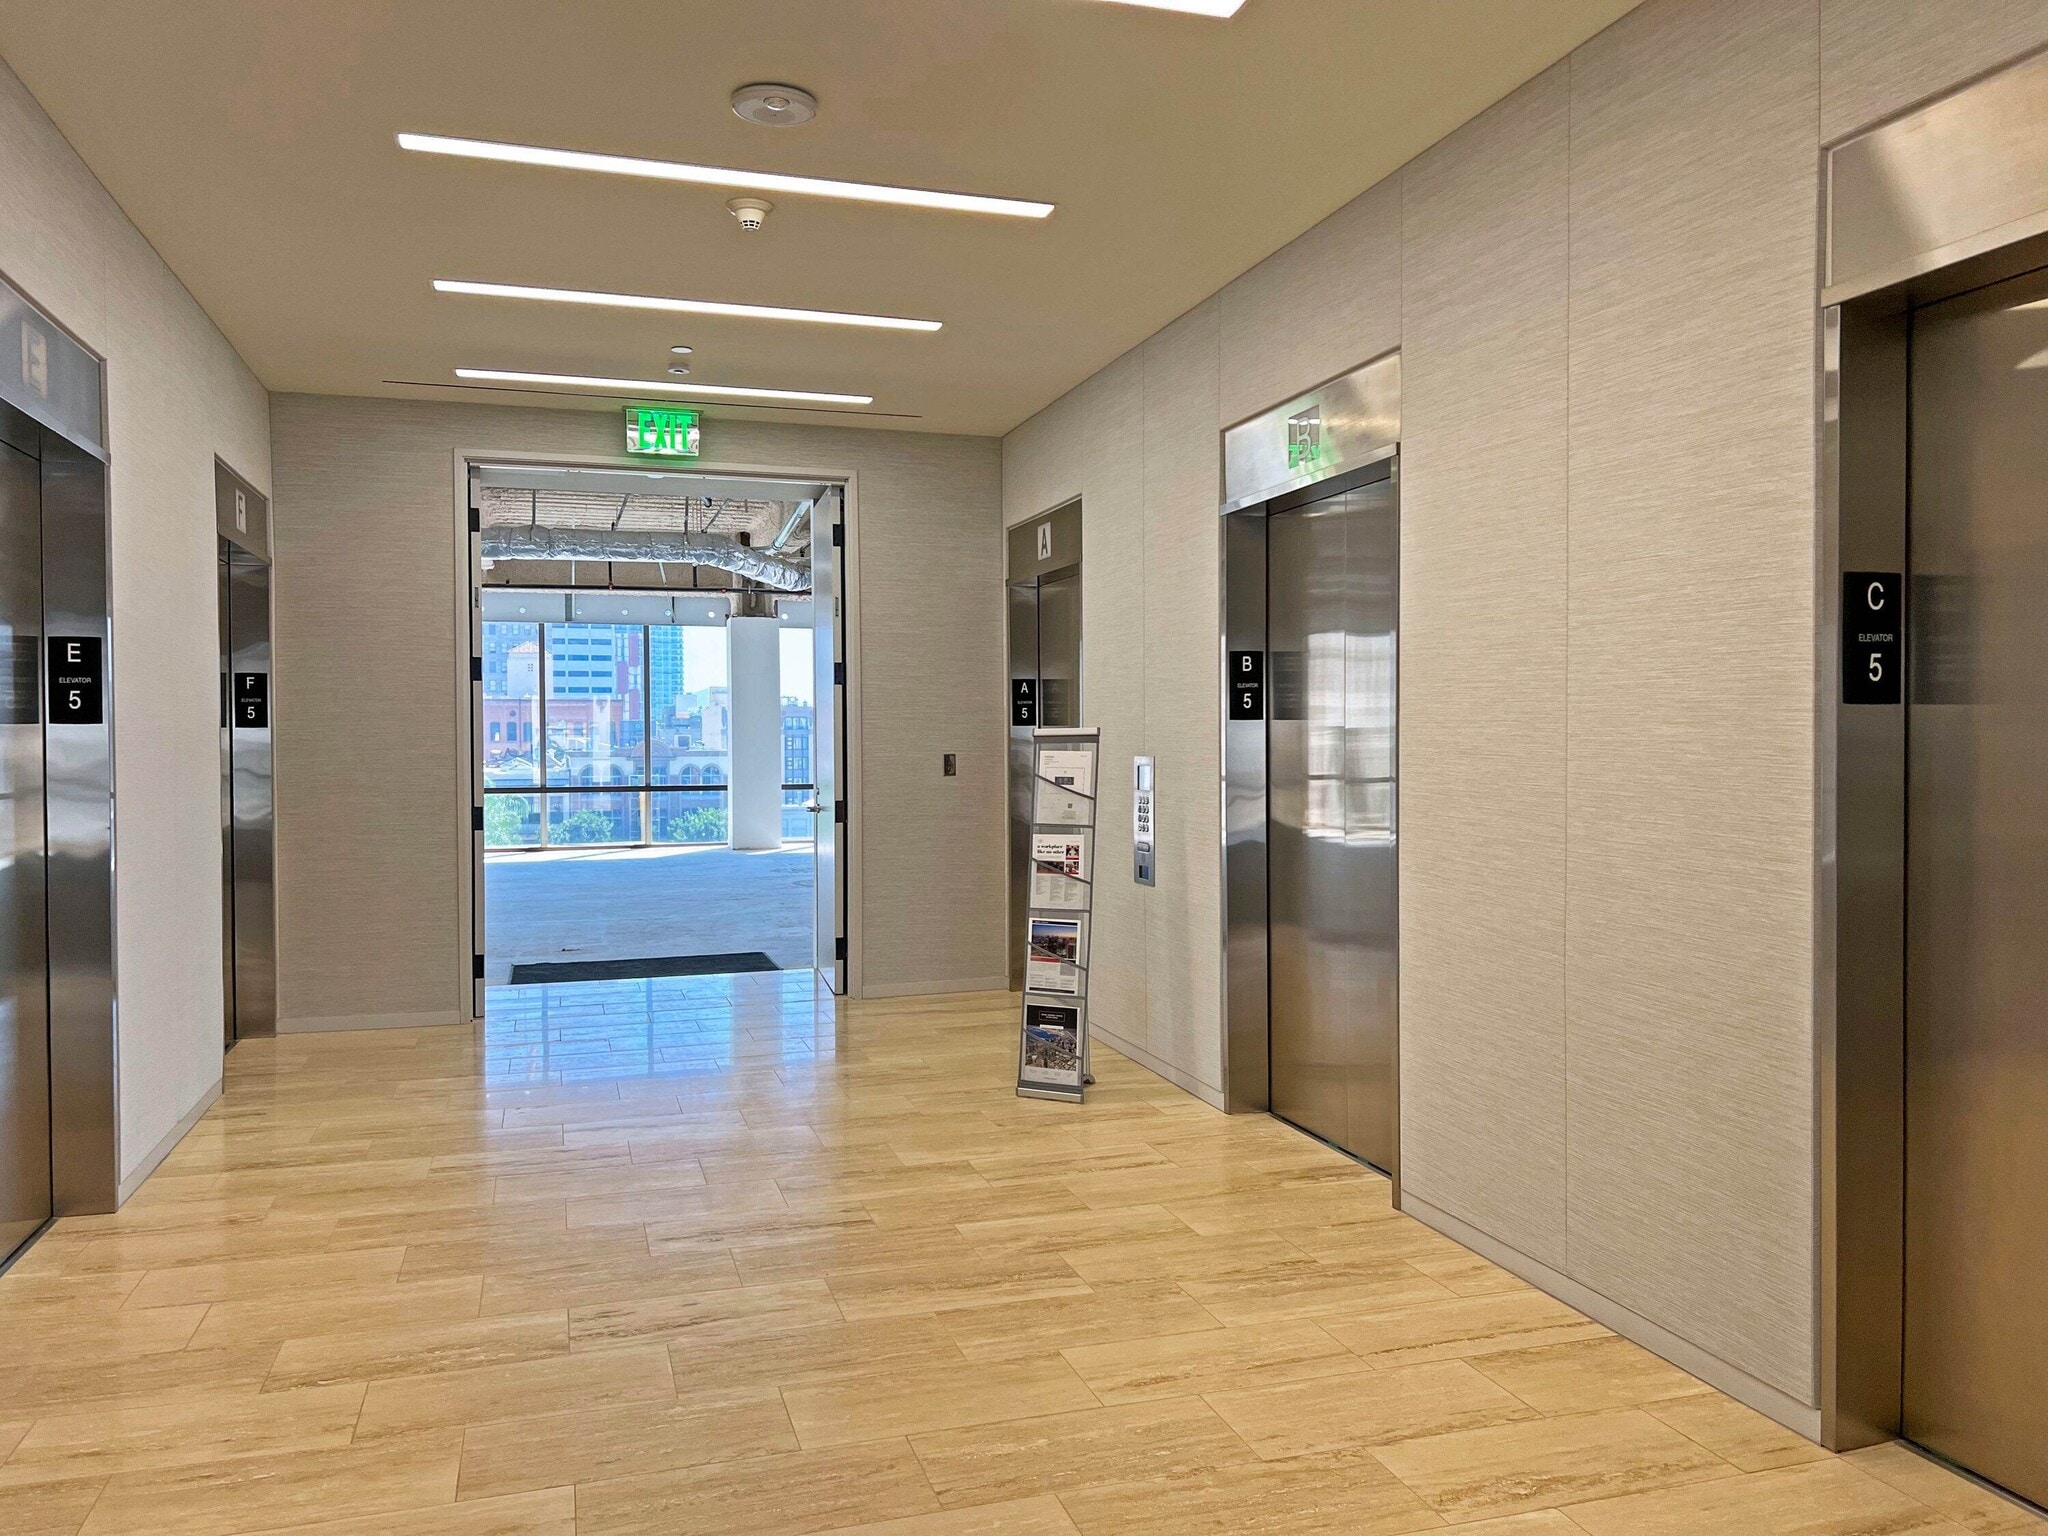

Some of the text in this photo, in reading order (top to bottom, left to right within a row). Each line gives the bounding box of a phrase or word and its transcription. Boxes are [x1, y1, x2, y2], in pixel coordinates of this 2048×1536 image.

[638, 411, 692, 451] EXIT
[1297, 417, 1311, 460] B
[1041, 528, 1048, 556] A
[1867, 581, 1885, 611] C
[1858, 633, 1894, 642] ELEVATOR
[67, 643, 81, 662] E
[1242, 656, 1252, 672] B
[1868, 653, 1883, 682] 5
[246, 676, 255, 690] F
[1020, 682, 1029, 694] A
[68, 690, 81, 710] 5
[1243, 693, 1252, 709] 5
[247, 706, 255, 719] 5
[1021, 707, 1028, 719] 5
